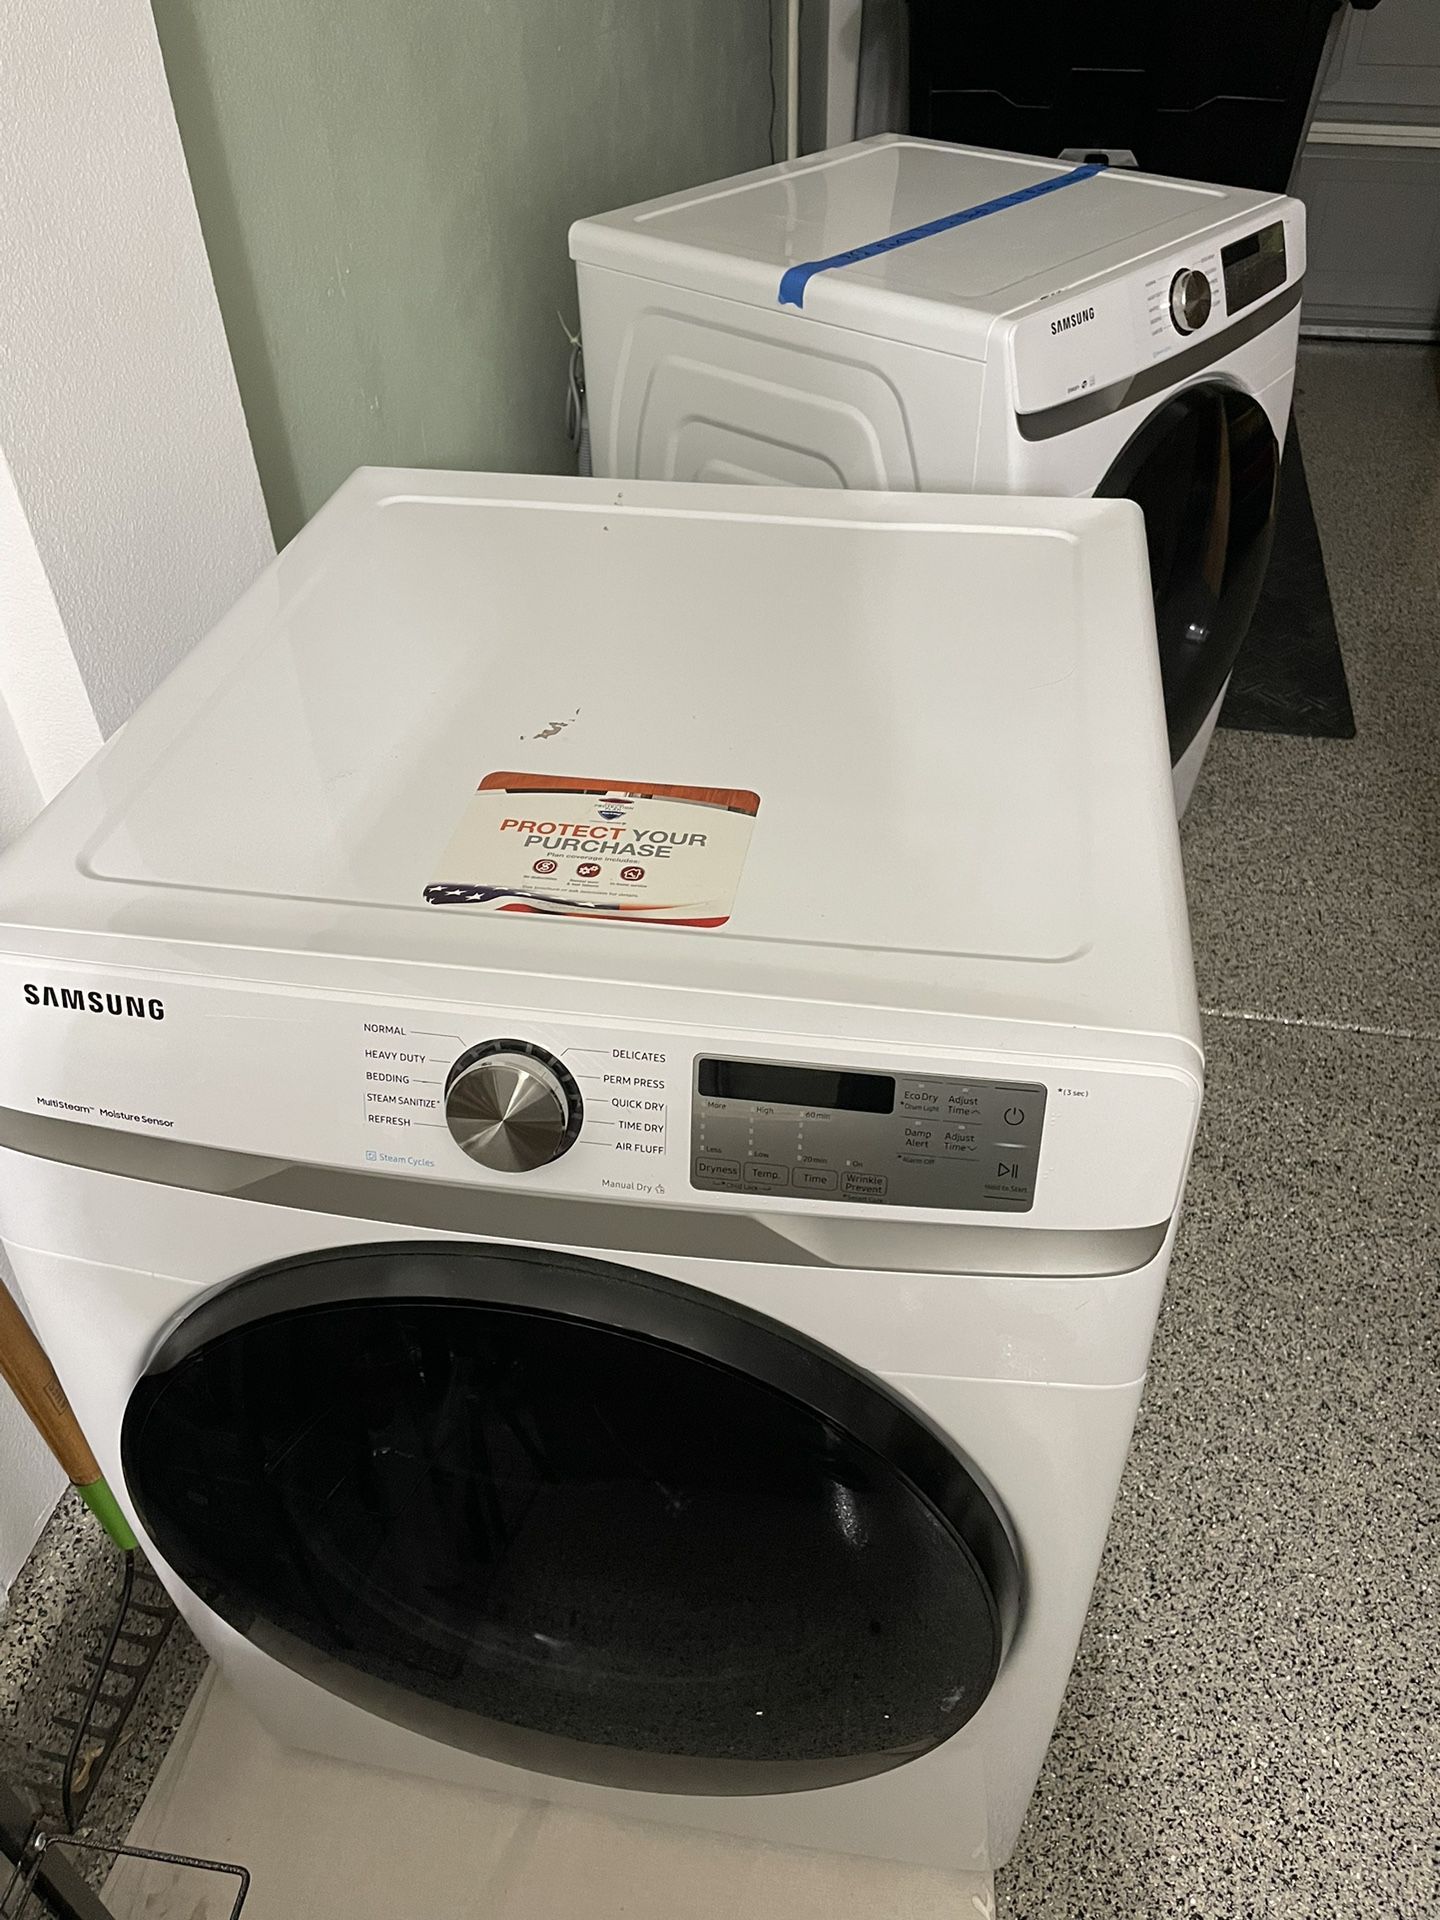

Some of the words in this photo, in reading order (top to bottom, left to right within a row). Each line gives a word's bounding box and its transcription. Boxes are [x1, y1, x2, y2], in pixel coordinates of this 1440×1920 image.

[1050, 307, 1096, 336] SAMSUNG
[500, 818, 626, 841] PROTECT
[632, 829, 708, 847] YOUR
[523, 835, 673, 859] PURCHASE
[546, 851, 565, 859] Plan
[566, 854, 603, 862] coverage
[23, 983, 165, 1021] SAMSUNG
[363, 1023, 407, 1036] NORMAL
[364, 1049, 398, 1062] HEAVY
[399, 1052, 426, 1064] DUTY
[612, 1048, 667, 1063] DELICATES
[365, 1071, 410, 1085] BEDDING
[602, 1074, 632, 1086] PERM
[632, 1076, 665, 1090] PRESS
[366, 1093, 397, 1106] STEAM
[611, 1097, 643, 1109] QUICK
[643, 1100, 665, 1112] DRY
[707, 1101, 727, 1110] More
[948, 1095, 979, 1106] Adjust
[756, 1106, 774, 1115] High
[805, 1111, 815, 1119] 60
[948, 1105, 970, 1116] Time
[99, 1108, 141, 1122] Moisture
[141, 1115, 175, 1128] Sensor
[368, 1114, 411, 1127] REFRESH
[618, 1120, 643, 1132] TIME
[642, 1123, 664, 1134] DRY
[904, 1127, 932, 1139] Damp
[905, 1138, 929, 1149] Alert
[944, 1131, 975, 1143] Adjust
[615, 1141, 635, 1152] AIR
[634, 1143, 664, 1155] FLUFF
[706, 1146, 722, 1154] Less
[944, 1142, 966, 1152] Time
[379, 1152, 407, 1164] Steam
[407, 1156, 435, 1168] Cycles
[754, 1150, 769, 1159] Low
[802, 1155, 812, 1163] 20
[699, 1162, 738, 1175] Dryness
[852, 1160, 863, 1168] On
[804, 1173, 828, 1184] Time
[846, 1174, 883, 1186] Wrinkle
[601, 1179, 634, 1191] Manual
[636, 1183, 653, 1194] Dry
[845, 1182, 883, 1194] Prevent
